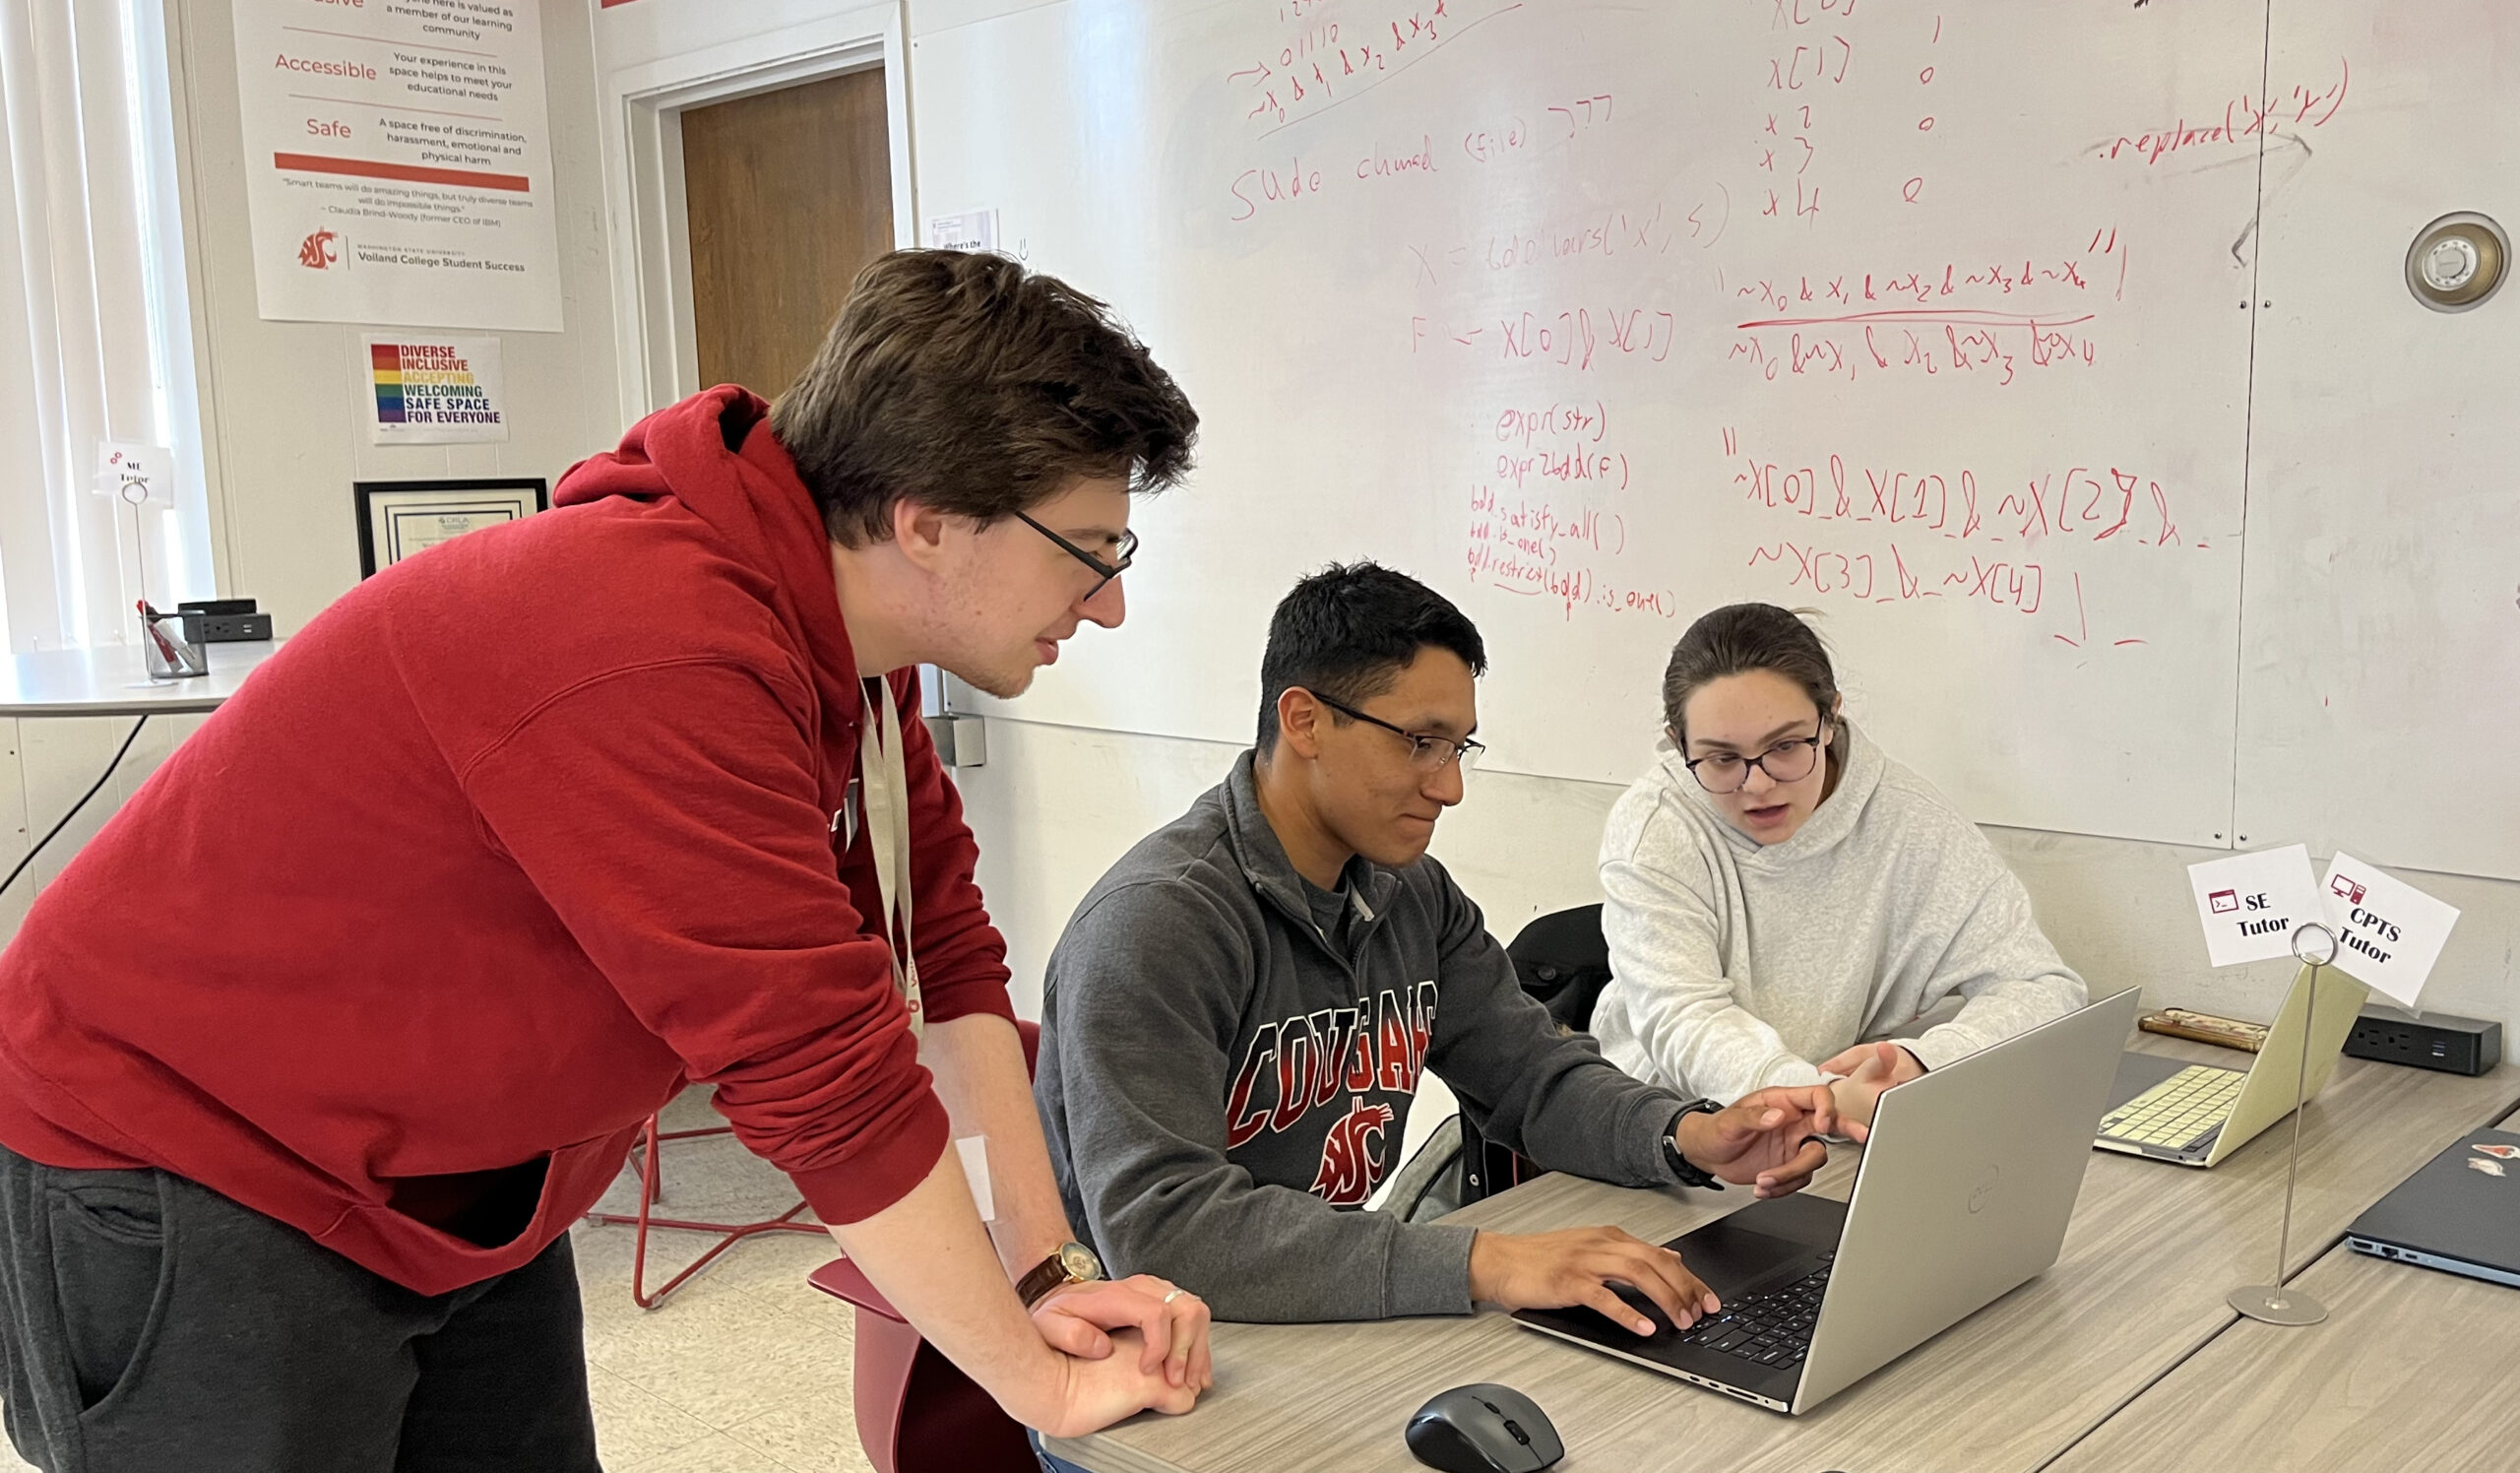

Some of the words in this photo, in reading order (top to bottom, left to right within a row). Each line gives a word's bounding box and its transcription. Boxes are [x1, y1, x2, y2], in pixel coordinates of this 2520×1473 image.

[458, 1, 466, 10] is
[468, 3, 500, 15] valued
[387, 5, 393, 14] a
[395, 6, 438, 19] member
[453, 14, 470, 24] our
[472, 17, 513, 32] learning
[422, 24, 480, 40] community
[276, 54, 377, 81] Accessible
[394, 52, 417, 63] Your
[419, 56, 474, 71] experience
[476, 62, 486, 73] in
[488, 65, 507, 75] this
[389, 66, 419, 78] space
[421, 70, 449, 82] helps
[451, 74, 462, 83] to
[464, 76, 489, 87] meet
[491, 80, 513, 90] your
[407, 83, 467, 96] educational
[469, 91, 498, 100] needs
[306, 118, 352, 139] Safe
[379, 118, 387, 127] A
[389, 119, 418, 131] space
[420, 123, 441, 133] free
[455, 128, 528, 144] discrimination,
[387, 133, 450, 149] harassment,
[451, 141, 501, 154] emotional
[503, 145, 522, 156] and
[421, 151, 463, 162] physical
[465, 155, 491, 165] harm
[315, 181, 344, 191] teams
[374, 187, 410, 198] amazing
[441, 191, 457, 201] but
[458, 193, 476, 204] truly
[478, 196, 507, 206] diverse
[509, 199, 534, 208] teams
[358, 197, 373, 206] will
[387, 199, 431, 210] impossible
[328, 205, 360, 216] Claudia
[453, 216, 472, 224] CEO
[970, 239, 980, 248] the
[401, 255, 440, 268] College
[443, 257, 482, 270] Student
[485, 260, 526, 272] Success
[401, 345, 456, 358] DIVERSE
[402, 358, 469, 371] INCLUSIVE
[404, 371, 475, 385] ACCEPTING
[405, 384, 482, 398] WELCOMING
[406, 398, 441, 410] SAFE
[447, 398, 490, 411] SPACE
[408, 411, 432, 423] FOR
[437, 412, 501, 424] EVERYONE
[2245, 893, 2271, 912] SE
[2236, 917, 2289, 937] Tutor
[2350, 908, 2401, 942] CPTS
[2339, 927, 2391, 964] Tutor
